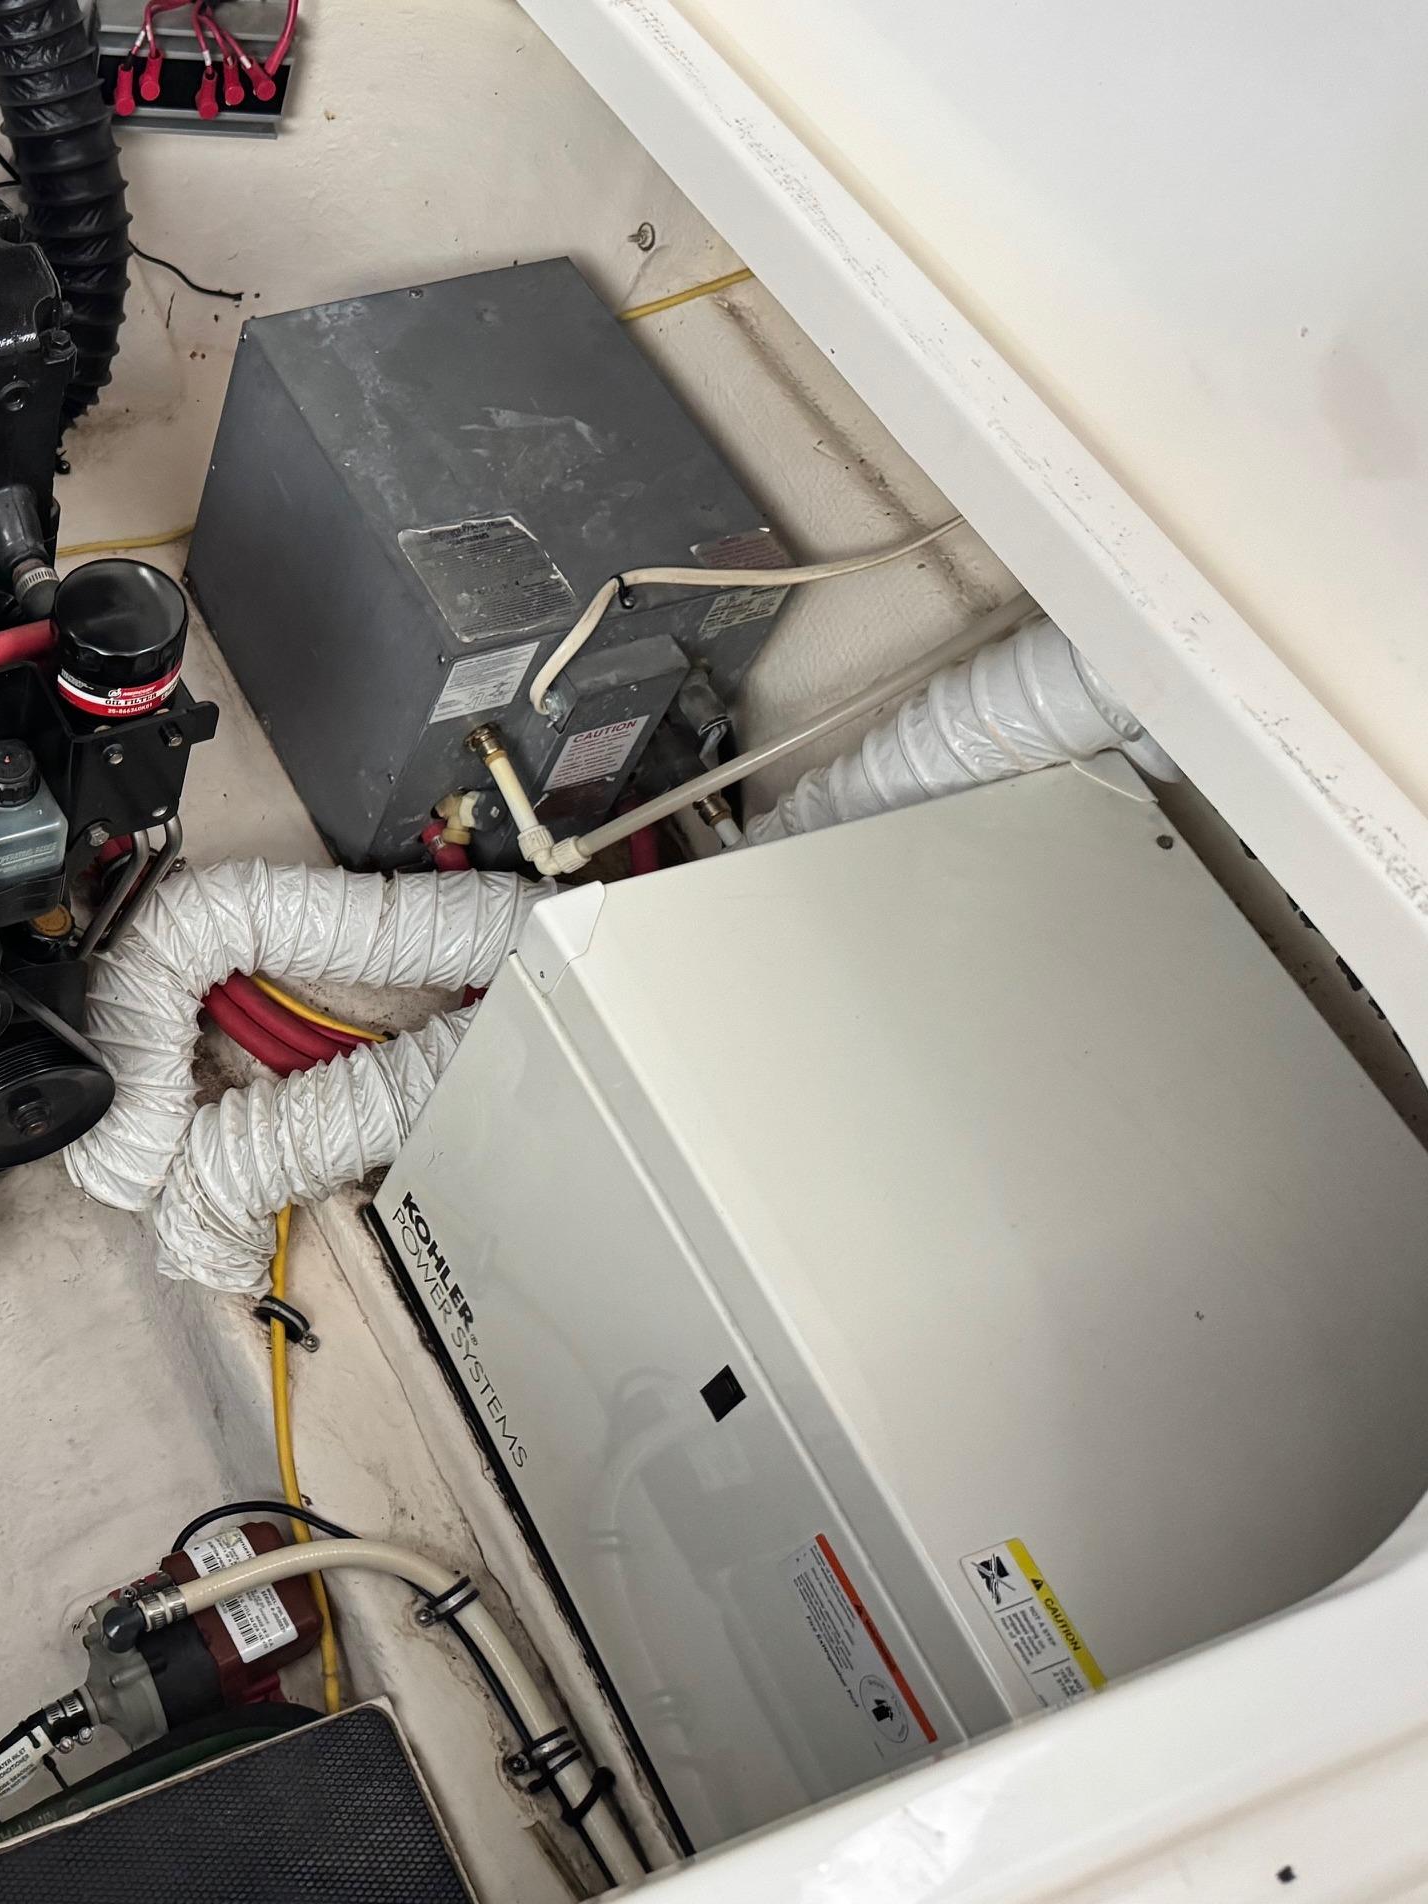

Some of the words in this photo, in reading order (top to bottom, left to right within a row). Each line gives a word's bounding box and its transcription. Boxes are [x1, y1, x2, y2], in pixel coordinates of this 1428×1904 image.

[124, 692, 157, 705] FILTER
[573, 718, 638, 744] CAUTION
[401, 1191, 475, 1332] KOHLER
[390, 1206, 455, 1324] POWER
[447, 1325, 531, 1468] SYSTEMS
[1027, 1604, 1041, 1621] NOT
[1041, 1627, 1057, 1647] STEP
[1041, 1596, 1082, 1652] CAUTION
